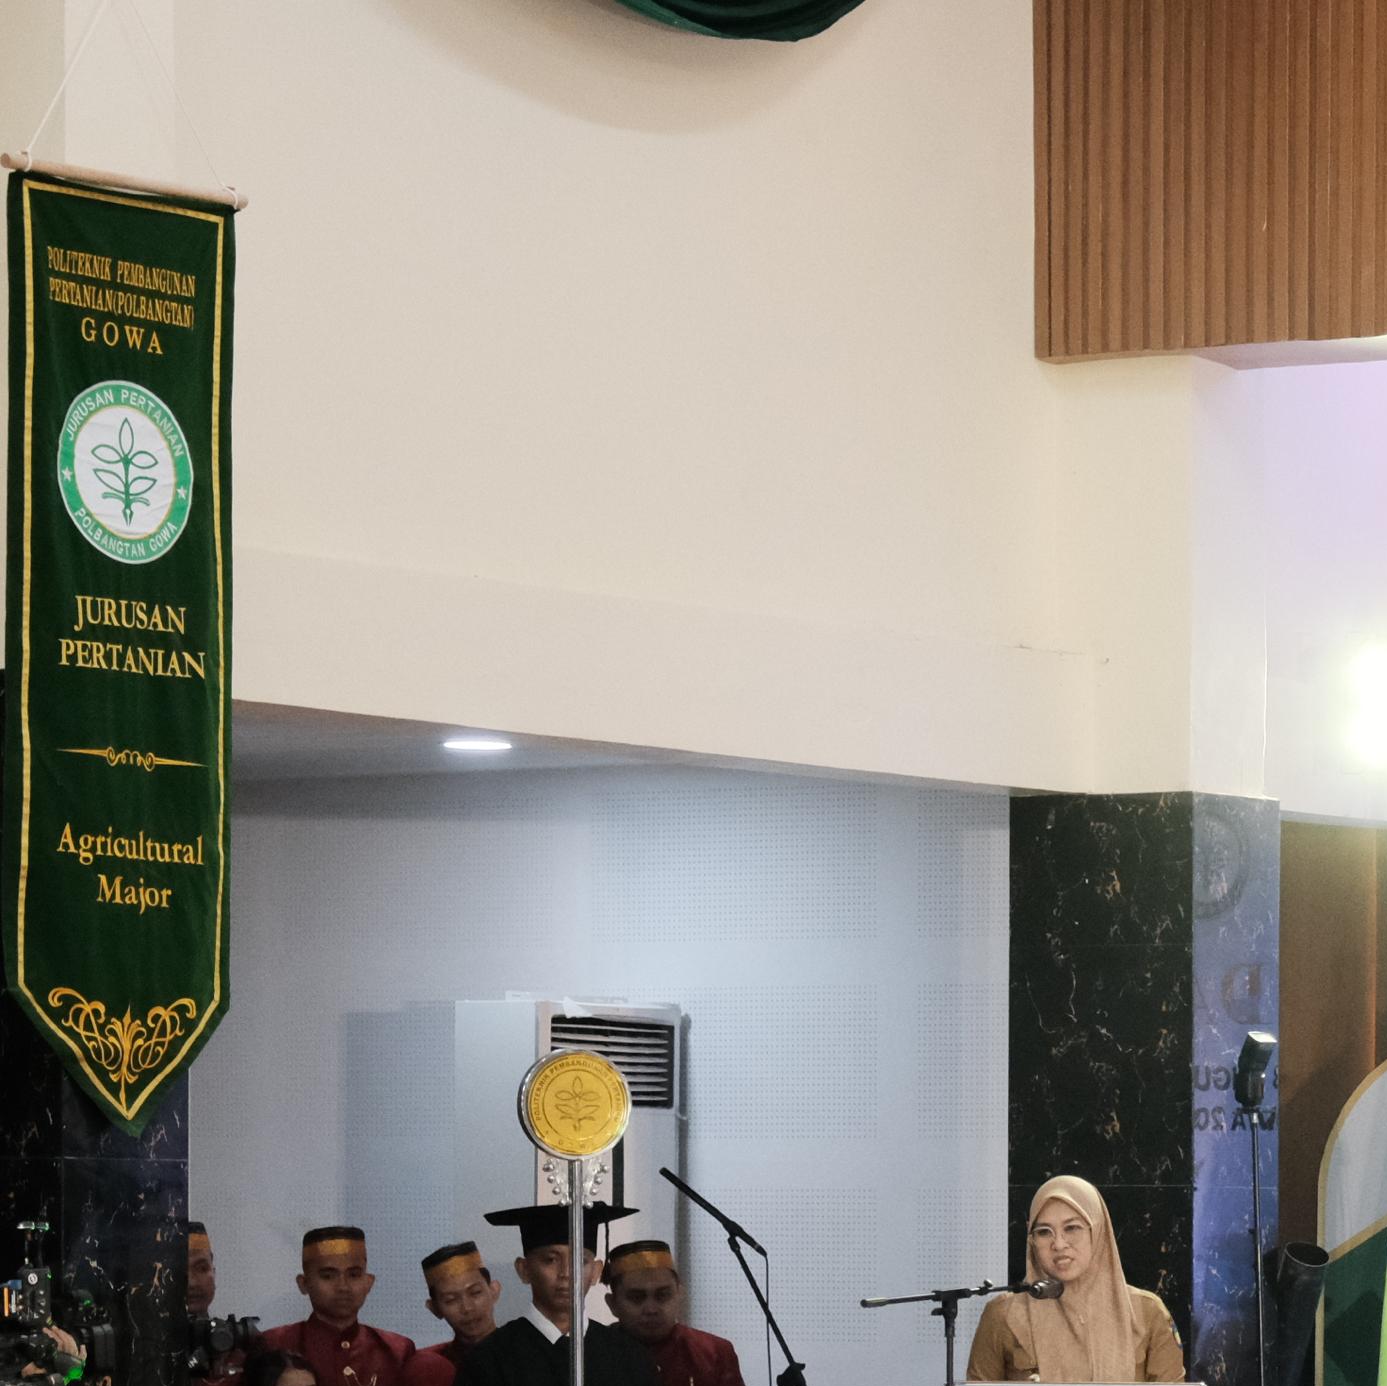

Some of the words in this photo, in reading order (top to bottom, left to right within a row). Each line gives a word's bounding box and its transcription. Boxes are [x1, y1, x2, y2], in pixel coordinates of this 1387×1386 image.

[47, 246, 112, 281] POLITEKNIK
[117, 260, 195, 297] PEMBANGUNAN
[81, 317, 163, 355] GOWA
[68, 389, 114, 441] JURUSAN
[120, 389, 185, 457] PERTANIAN
[74, 507, 146, 557] POLBANGTAN
[149, 521, 178, 551] GOWA
[74, 595, 186, 635] JURUSAN
[58, 638, 206, 680] PERTANIAN
[56, 822, 204, 866] Agricultural
[96, 874, 172, 914] Major
